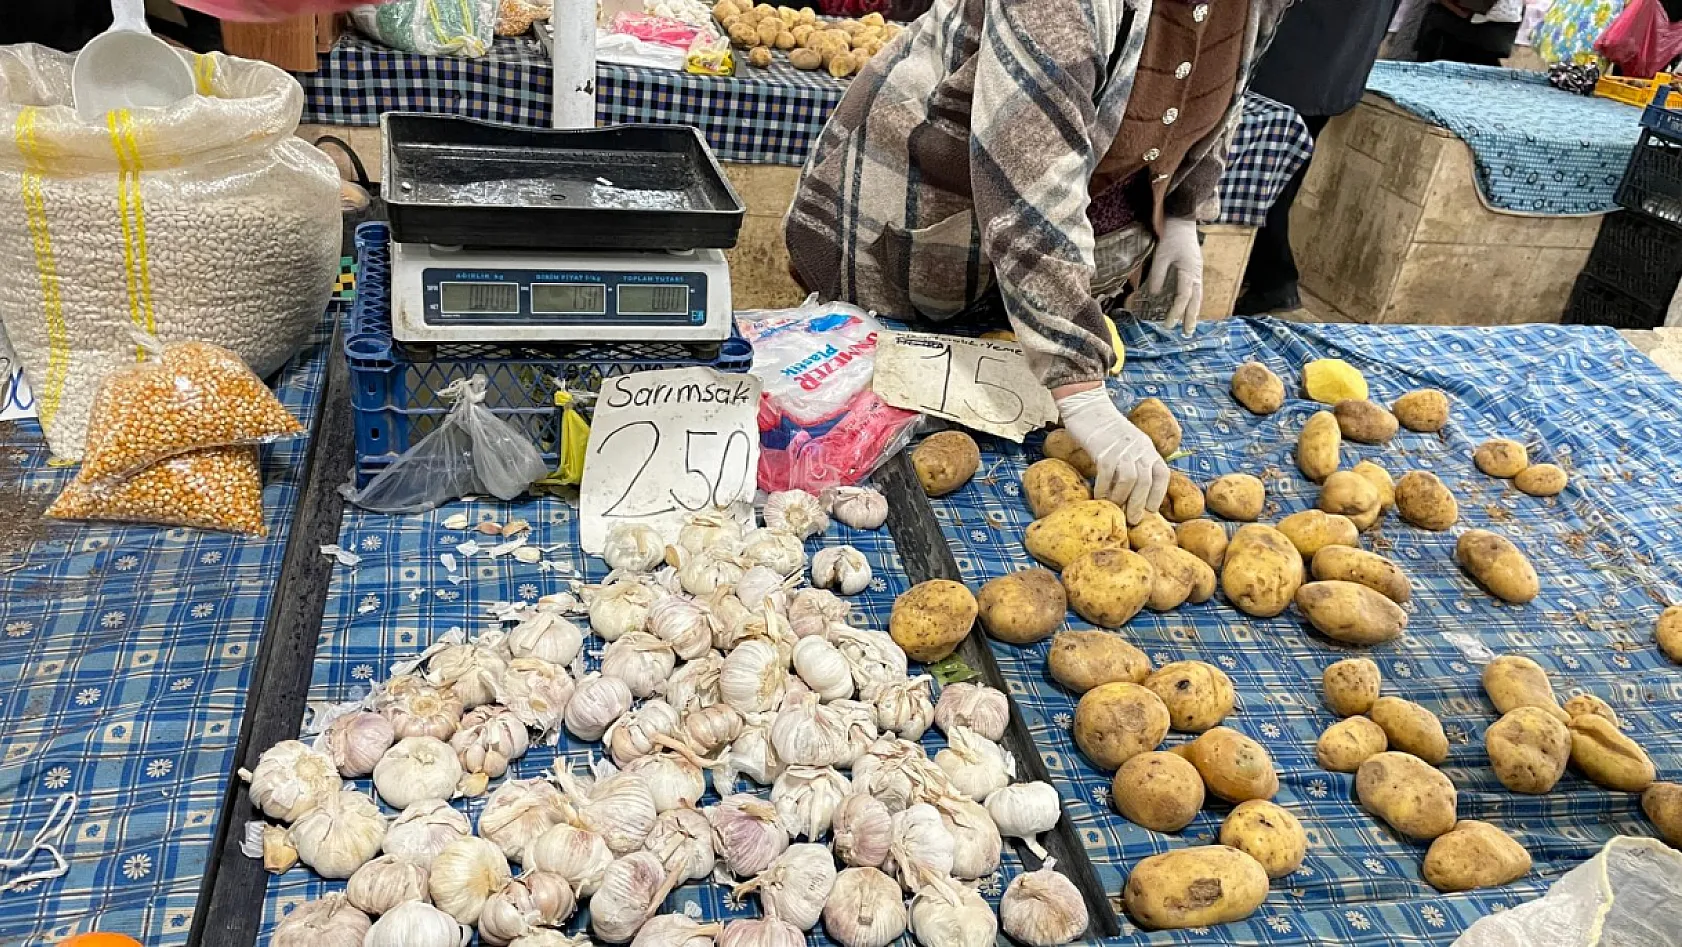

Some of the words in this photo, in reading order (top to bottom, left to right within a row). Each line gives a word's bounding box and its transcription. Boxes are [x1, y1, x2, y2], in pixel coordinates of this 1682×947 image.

[779, 343, 840, 377] Plastik
[607, 375, 751, 408] Sarımsak
[919, 344, 1025, 425] 15
